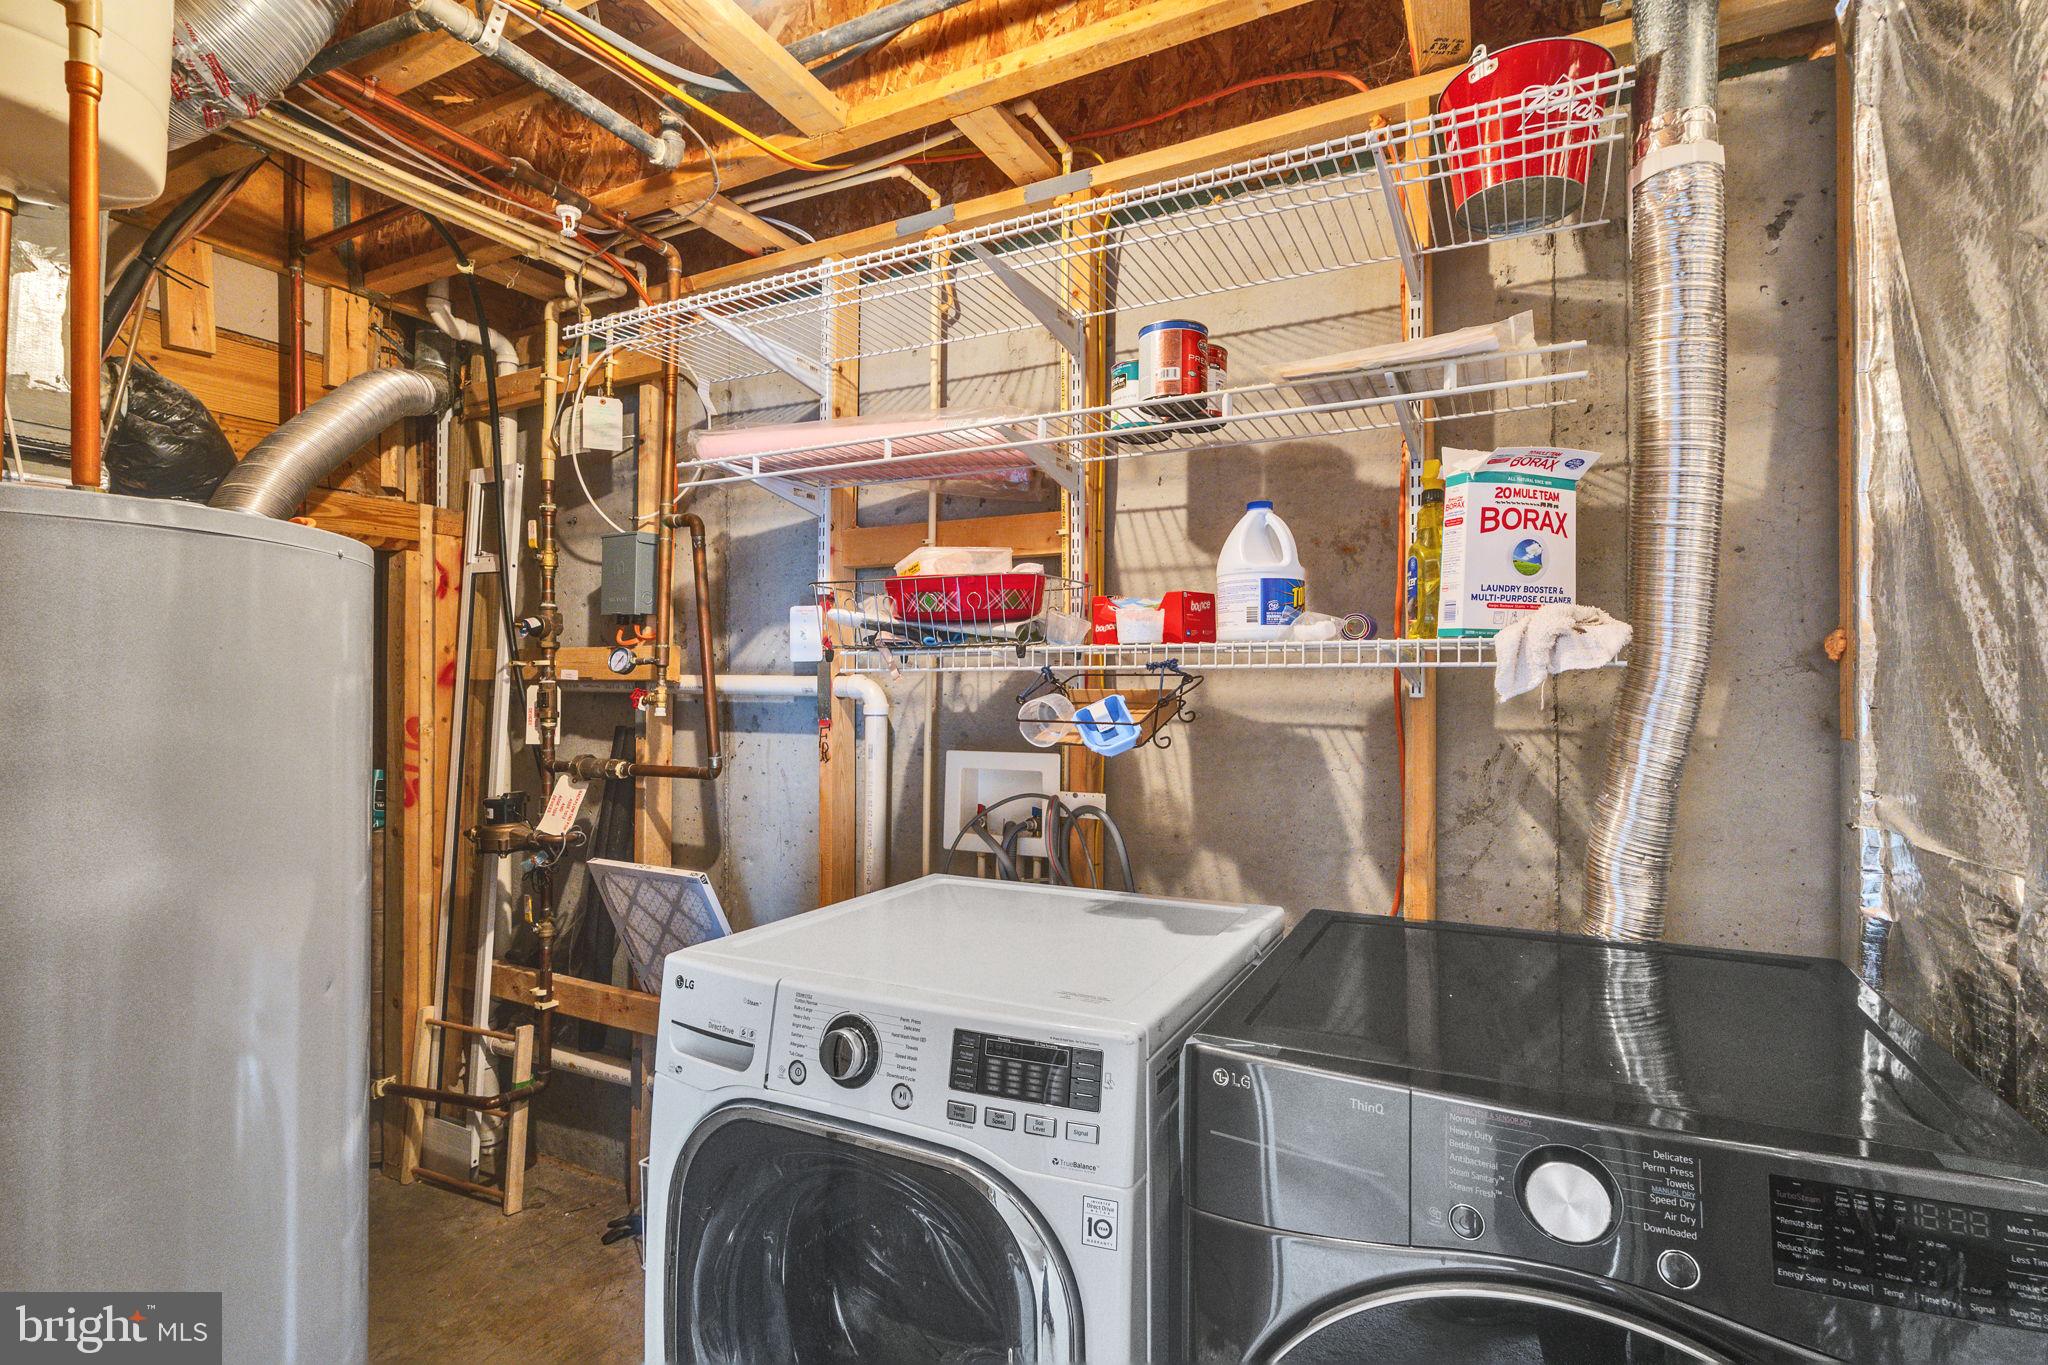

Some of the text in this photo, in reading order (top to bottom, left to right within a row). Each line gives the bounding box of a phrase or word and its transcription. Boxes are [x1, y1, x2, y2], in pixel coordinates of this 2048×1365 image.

[1510, 457, 1560, 472] BORAX
[1495, 487, 1560, 502] 20 MULE TEAM
[1445, 501, 1465, 512] BORAX
[1480, 507, 1568, 538] BORAX
[1481, 584, 1521, 593] LAUNDRY
[1523, 585, 1557, 594] BOOSTER
[1470, 593, 1571, 604] MULTI-PURPOSE CLEANER
[1190, 600, 1211, 612] bounce
[1095, 623, 1118, 632] bounc
[708, 1021, 735, 1035] Direct Drive
[903, 1025, 921, 1033] Delicates
[906, 1044, 919, 1052] Towels
[1232, 1072, 1250, 1089] LG
[1350, 1098, 1384, 1115] ThinQ
[992, 1117, 1006, 1126] Speed
[994, 1112, 1005, 1120] Spin
[1449, 1113, 1477, 1125] Normal
[1495, 1113, 1519, 1124] SENSOR
[1033, 1125, 1046, 1133] Level
[1073, 1129, 1089, 1137] Signal
[1449, 1126, 1494, 1142] Heavy Duty
[1449, 1139, 1480, 1154] Bedding
[1449, 1153, 1498, 1170] Antibacterial
[1653, 1150, 1694, 1165] Delicates
[1448, 1167, 1470, 1178] Steam
[1642, 1161, 1694, 1178] Perm. Press
[1448, 1181, 1473, 1193] Steam
[1665, 1178, 1695, 1191] Towels
[1651, 1185, 1696, 1200] MANUAL DRY
[1776, 1189, 1822, 1202] TurboSteam
[1086, 1202, 1115, 1213] Direct Drive
[1649, 1193, 1696, 1212] Speed Dry
[1835, 1200, 1850, 1208] Sense
[1875, 1201, 1886, 1209] Dry
[1893, 1204, 1907, 1212] Cool
[1664, 1211, 1697, 1227] Air Dry
[1087, 1216, 1113, 1239] 10
[1643, 1222, 1698, 1240] Downloaded
[1806, 1220, 1824, 1231] Start
[1842, 1226, 1855, 1235] Very
[2006, 1224, 2030, 1236] More
[1881, 1233, 1896, 1241] High
[1777, 1241, 1825, 1257] Reduce Static
[1925, 1240, 1935, 1248] 60
[1843, 1246, 1865, 1255] Normal
[1883, 1252, 1908, 1262] Medium
[2011, 1254, 2031, 1265] Less
[1844, 1265, 1862, 1274] Damp
[1928, 1260, 1937, 1268] 40
[1777, 1267, 1827, 1284] Energy Saver
[1884, 1272, 1900, 1281] Ultra
[1832, 1278, 1869, 1293] Dry Level
[1929, 1280, 1938, 1288] 20
[2007, 1281, 2040, 1293] Wrinkle
[1969, 1286, 1993, 1297] On/Off
[1920, 1293, 1957, 1309] Time Dry
[1969, 1302, 1997, 1315] Signal
[2009, 1309, 2042, 1323] Damp Dry
